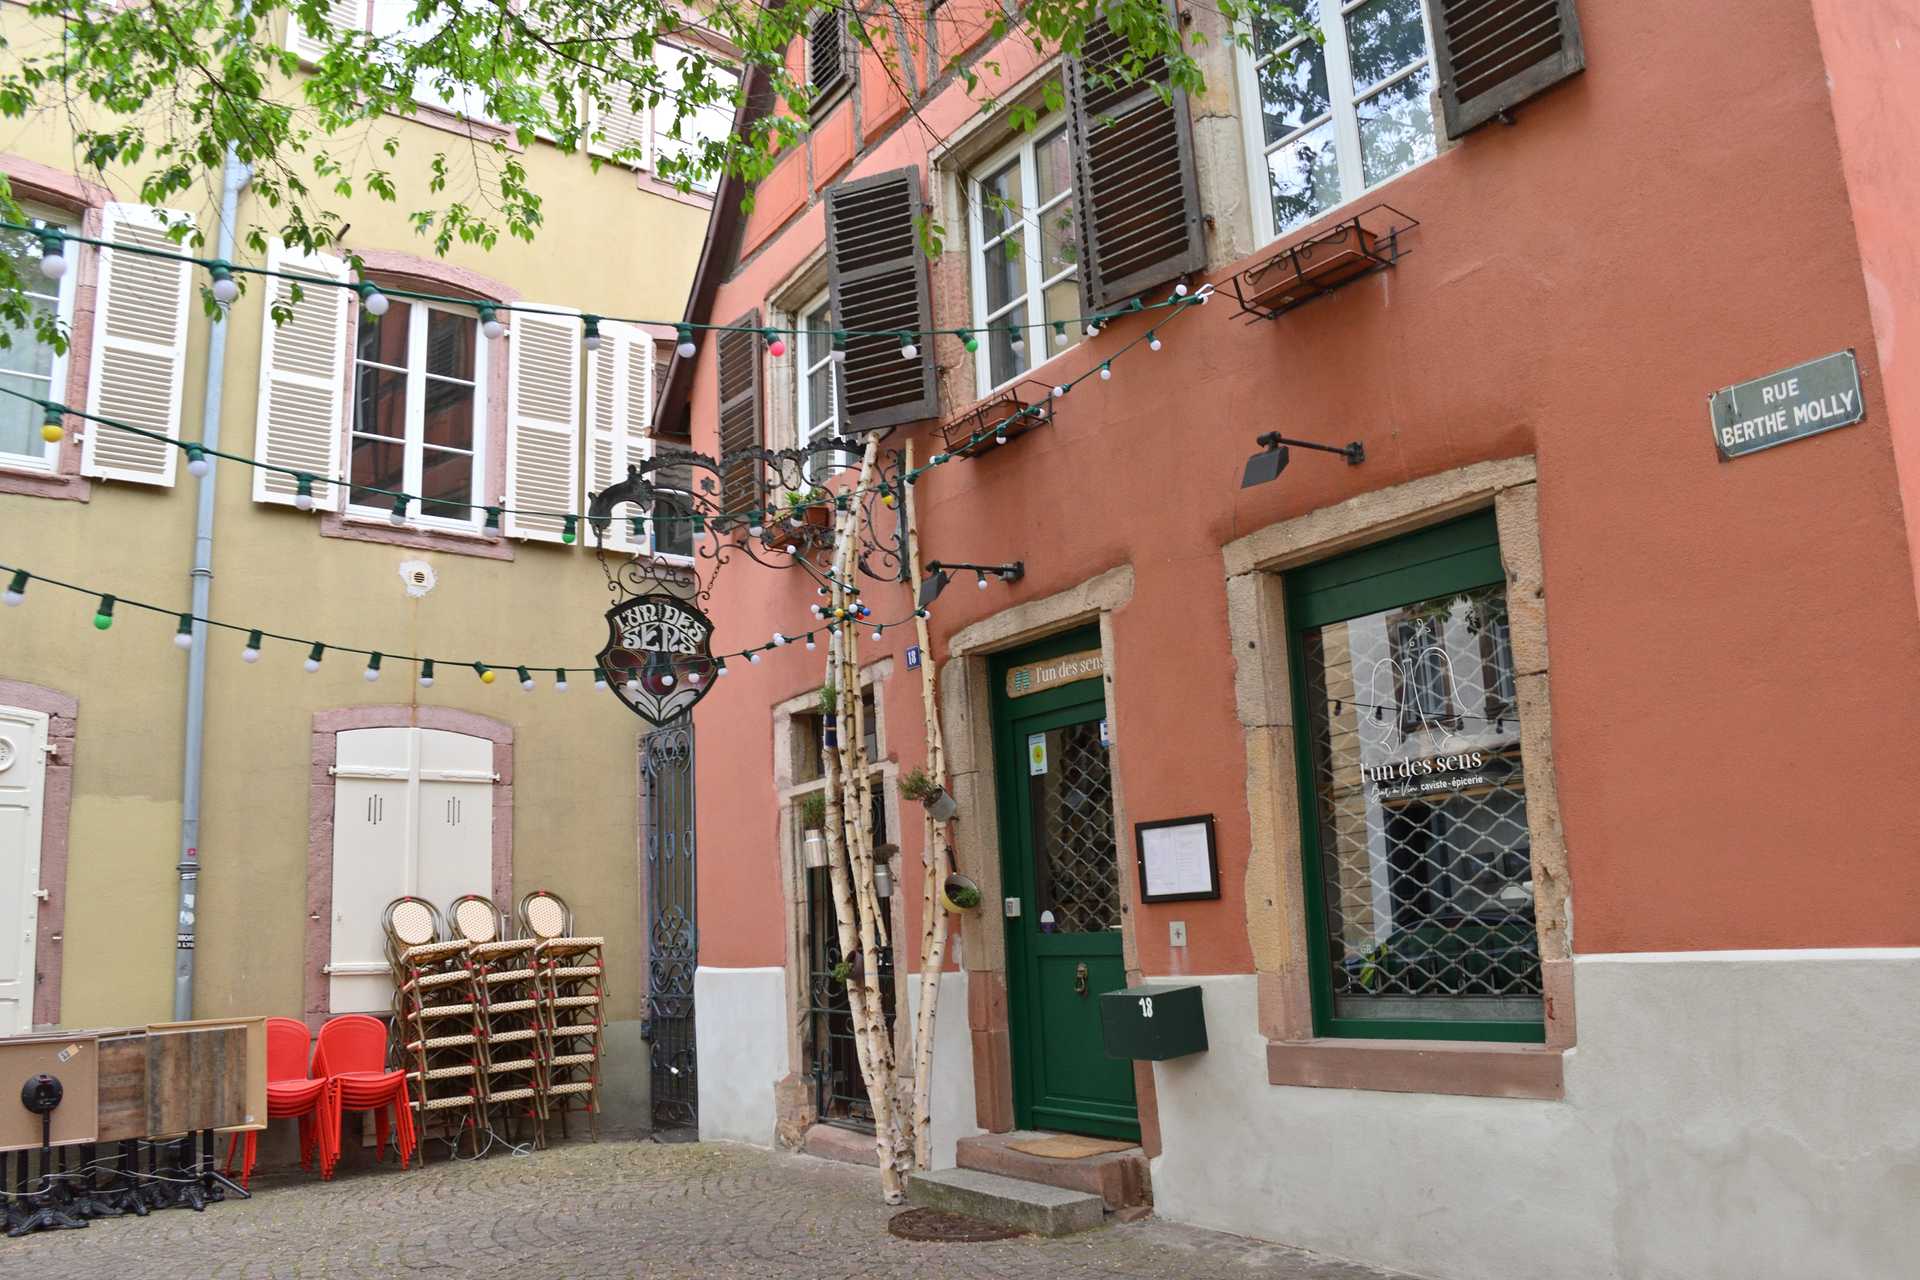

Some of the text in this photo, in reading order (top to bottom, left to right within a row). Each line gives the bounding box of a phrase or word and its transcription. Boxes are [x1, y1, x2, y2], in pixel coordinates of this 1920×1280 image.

[1762, 378, 1800, 405] RUE
[1793, 389, 1854, 426] MOLLY
[662, 604, 707, 642] DES
[622, 621, 697, 655] SENS
[908, 650, 917, 665] 18
[1036, 667, 1056, 684] l'un
[1058, 661, 1078, 679] des
[1360, 751, 1482, 783] l'un des sens
[1138, 997, 1154, 1018] 18
